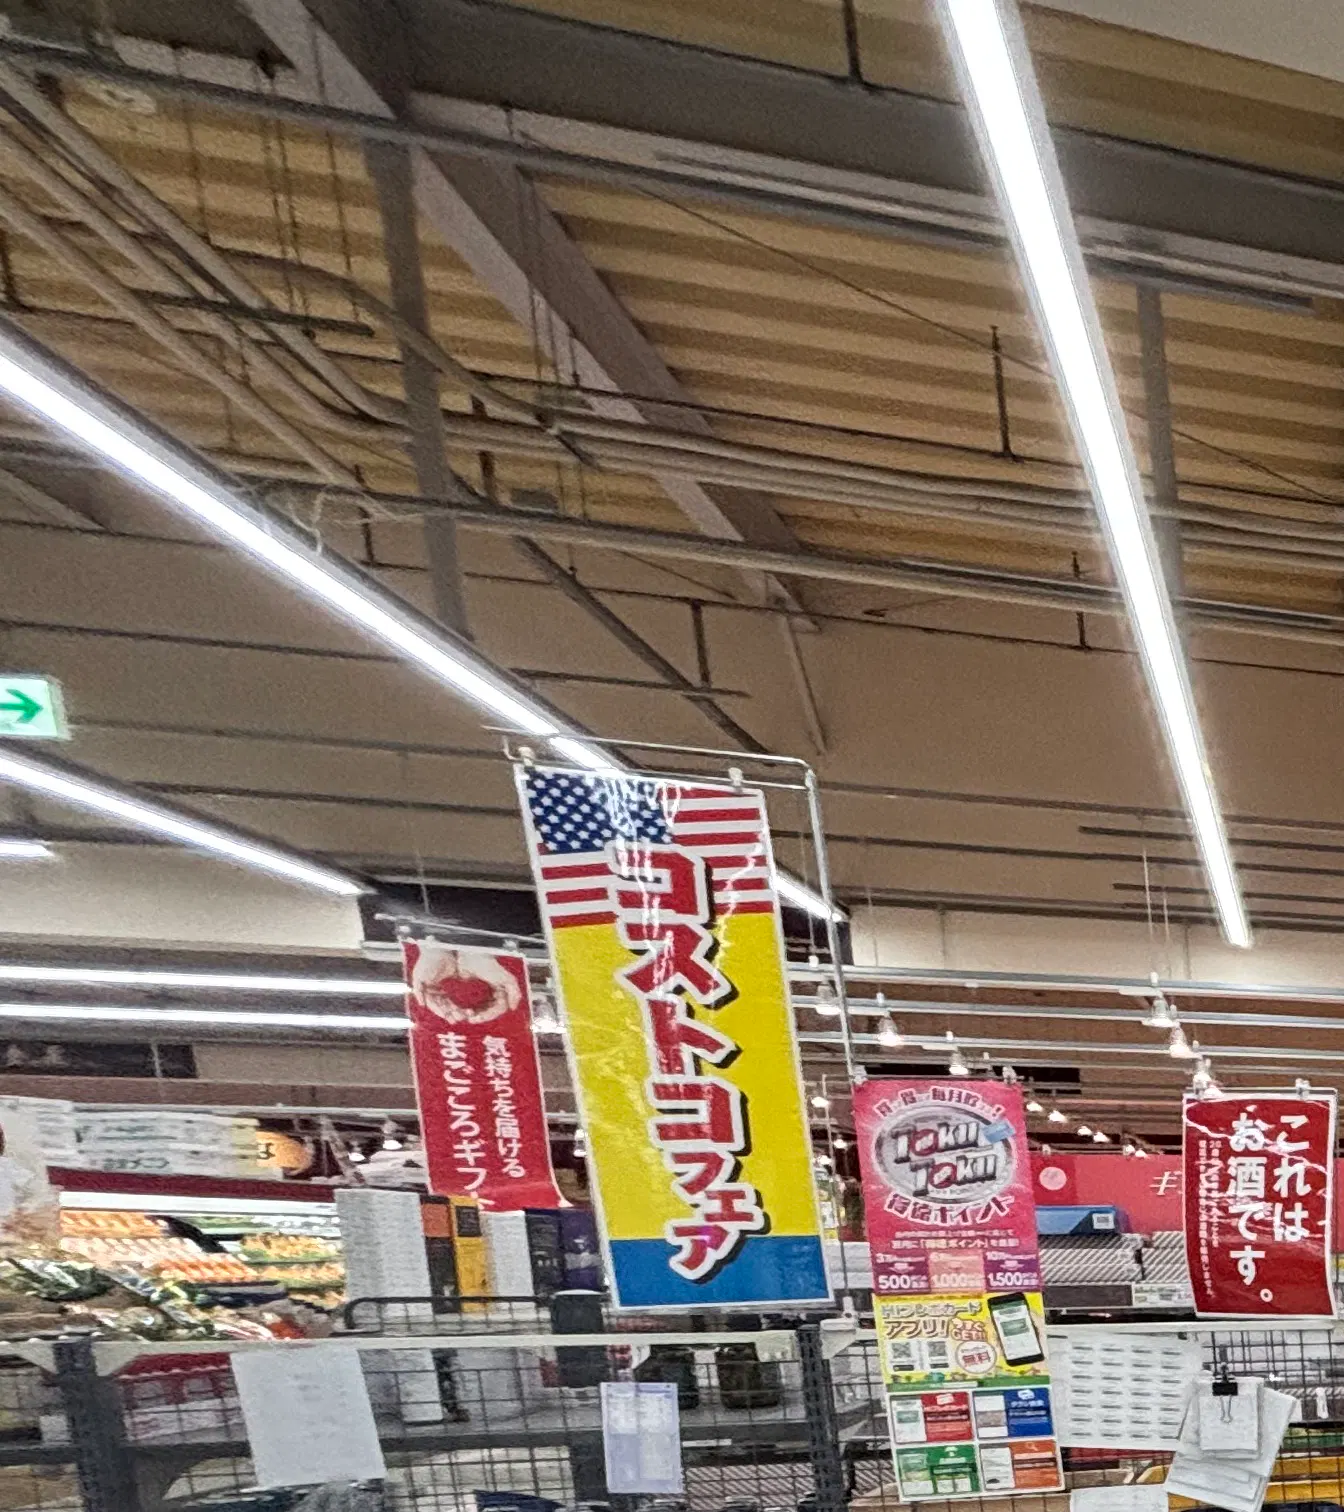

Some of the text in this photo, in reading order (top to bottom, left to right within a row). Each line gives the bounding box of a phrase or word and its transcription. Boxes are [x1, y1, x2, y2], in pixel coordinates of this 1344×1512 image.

[482, 1035, 527, 1178] 気持ちを届ける
[614, 848, 758, 1271] コストコフェア
[1228, 1112, 1275, 1303] お酒です。
[1273, 1115, 1311, 1242] これは
[878, 1275, 911, 1289] 500
